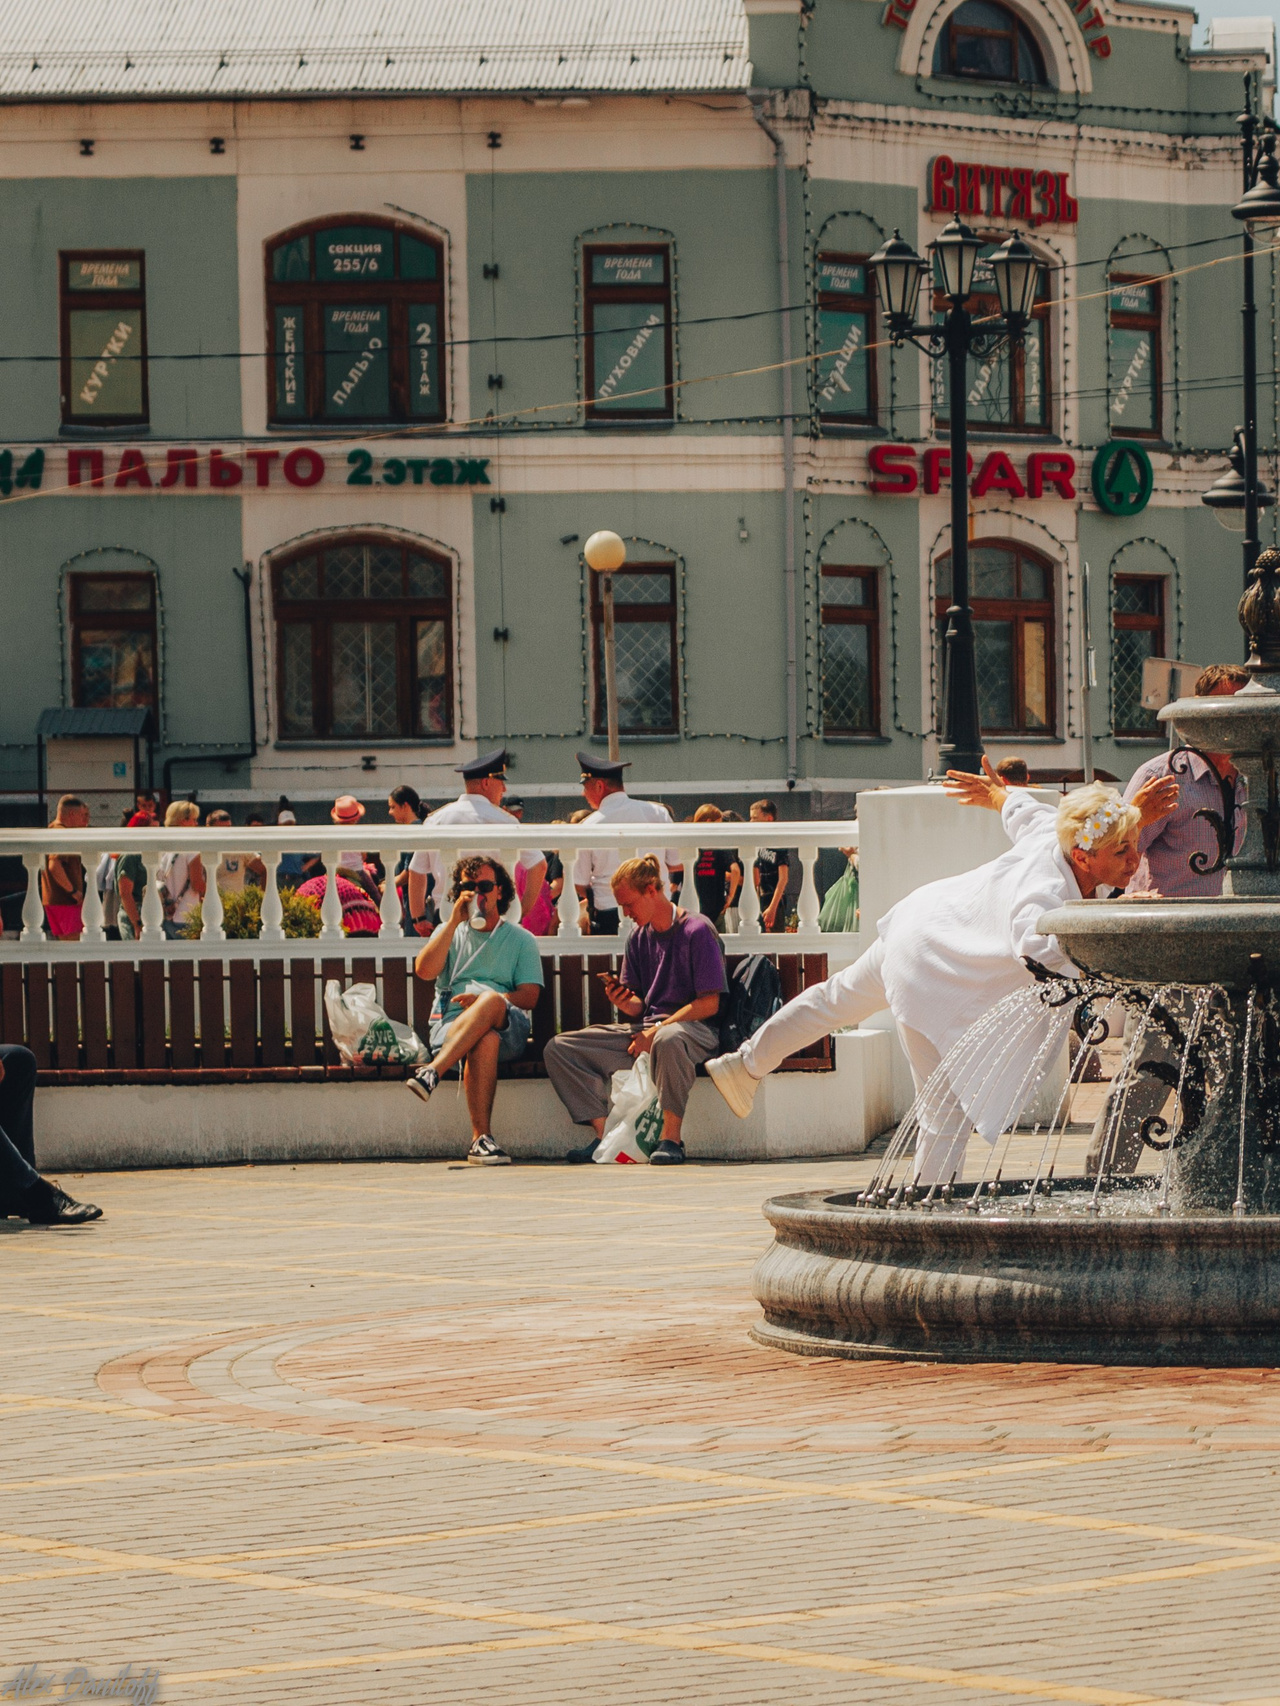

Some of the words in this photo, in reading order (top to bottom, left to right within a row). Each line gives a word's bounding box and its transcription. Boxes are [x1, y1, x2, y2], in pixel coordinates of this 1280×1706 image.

[929, 154, 1079, 227] ВИТЯЗЬ
[328, 243, 382, 255] секция
[80, 263, 130, 276] ВРЕМЕНА
[333, 258, 378, 274] 255/6
[604, 257, 653, 268] ВРЕМЕНА
[616, 269, 641, 280] ГОДА
[822, 265, 859, 279] ВРЕМЕНА
[973, 270, 997, 287] 255/
[91, 275, 119, 287] ГОДА
[830, 277, 850, 289] ГОДА
[1121, 297, 1139, 308] ГОДА
[331, 311, 380, 322] ВРЕМЕНА
[343, 322, 369, 333] ГОДА
[416, 323, 431, 344] 2
[283, 317, 296, 404] ЖЕНСКИЕ
[599, 314, 660, 397] ПУХОВИКИ
[821, 324, 862, 401] ПАЩИ
[419, 349, 430, 395] ЭТАЖ
[1110, 340, 1150, 415] КУРТКИ
[67, 447, 325, 488] ПАЛЬТО
[868, 445, 1076, 500] SPAR
